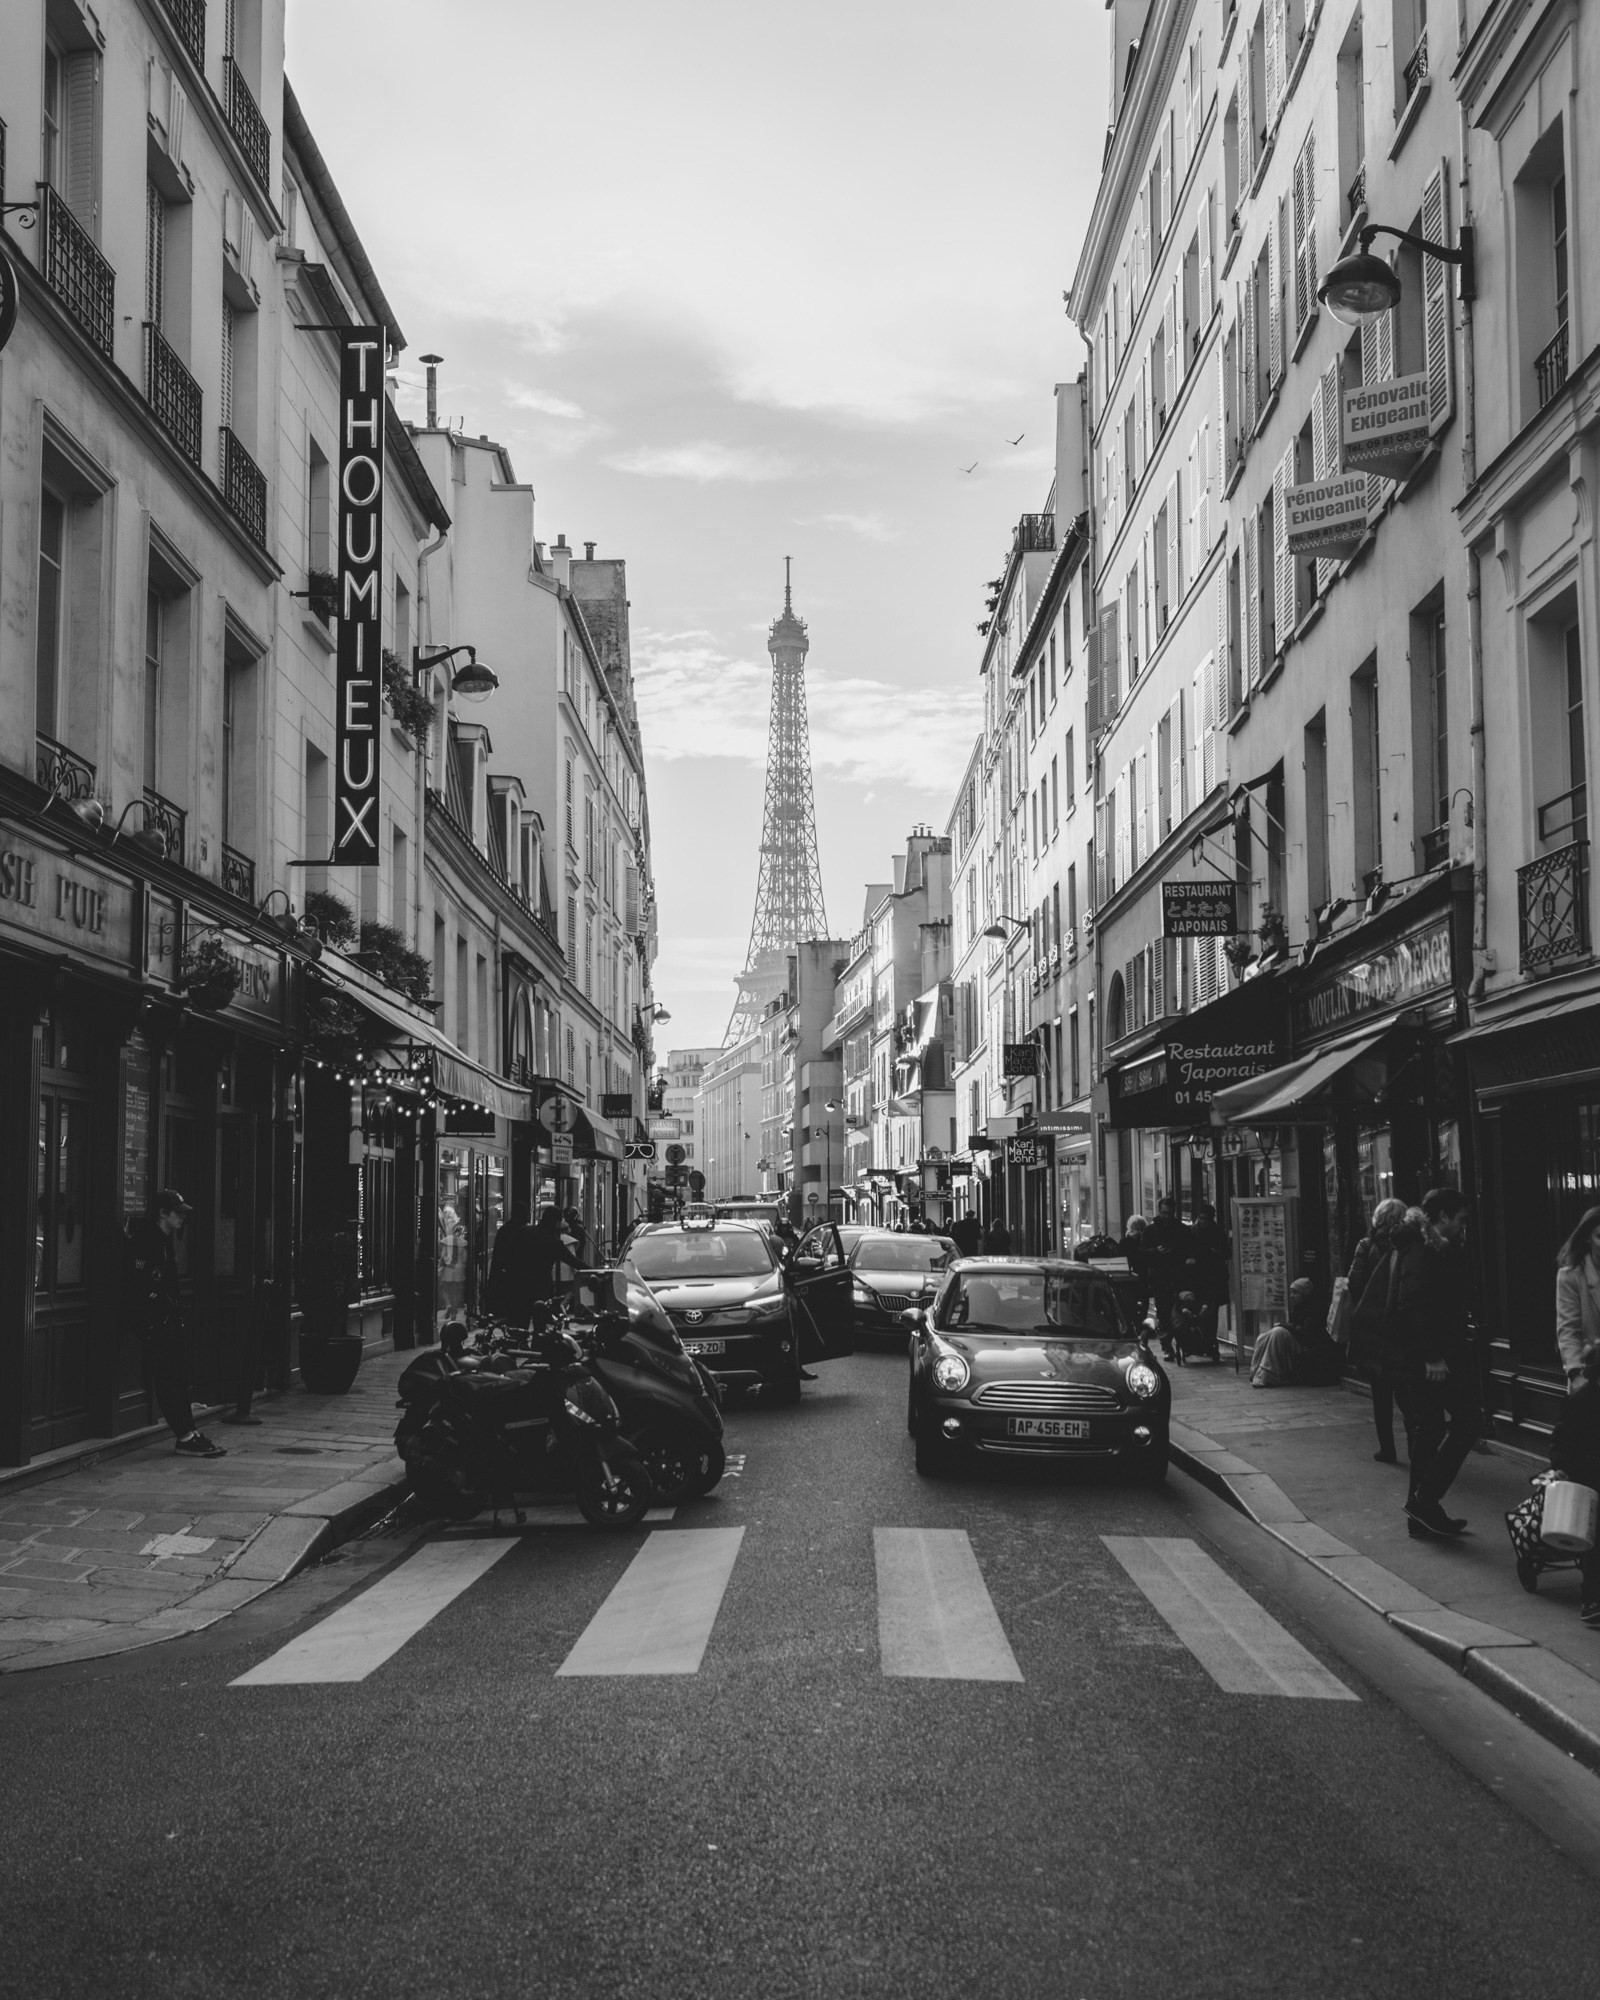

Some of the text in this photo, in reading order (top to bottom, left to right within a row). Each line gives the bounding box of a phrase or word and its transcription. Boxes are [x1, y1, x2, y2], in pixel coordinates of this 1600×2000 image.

[1351, 400, 1428, 432] Exigeant
[1367, 439, 1380, 449] 09
[1383, 436, 1393, 446] 81
[1397, 432, 1410, 442] 02
[1413, 428, 1426, 438] 20
[1308, 530, 1320, 540] 09
[1322, 527, 1332, 537] 81
[1336, 524, 1346, 533] 02
[1350, 520, 1361, 530] 20
[339, 342, 381, 848] THOUMIEUX
[0, 850, 104, 935] SH PUB
[1164, 884, 1232, 897] RESTAURANT
[1167, 901, 1231, 918] とよたか
[1171, 920, 1228, 933] JAPONAIS
[1309, 983, 1350, 1029] MOULIN
[1397, 930, 1451, 992] VIERGE
[1010, 1047, 1034, 1057] Karl
[1168, 1040, 1275, 1060] Restaurant
[1005, 1055, 1034, 1065] Marc
[1006, 1063, 1035, 1073] John
[1180, 1062, 1266, 1084] Japonais
[1175, 1091, 1212, 1104] 01 45
[1009, 1147, 1035, 1156] Marc
[1013, 1139, 1035, 1149] Karl
[1010, 1154, 1035, 1164] John
[1018, 1420, 1080, 1436] AP-456-EH
